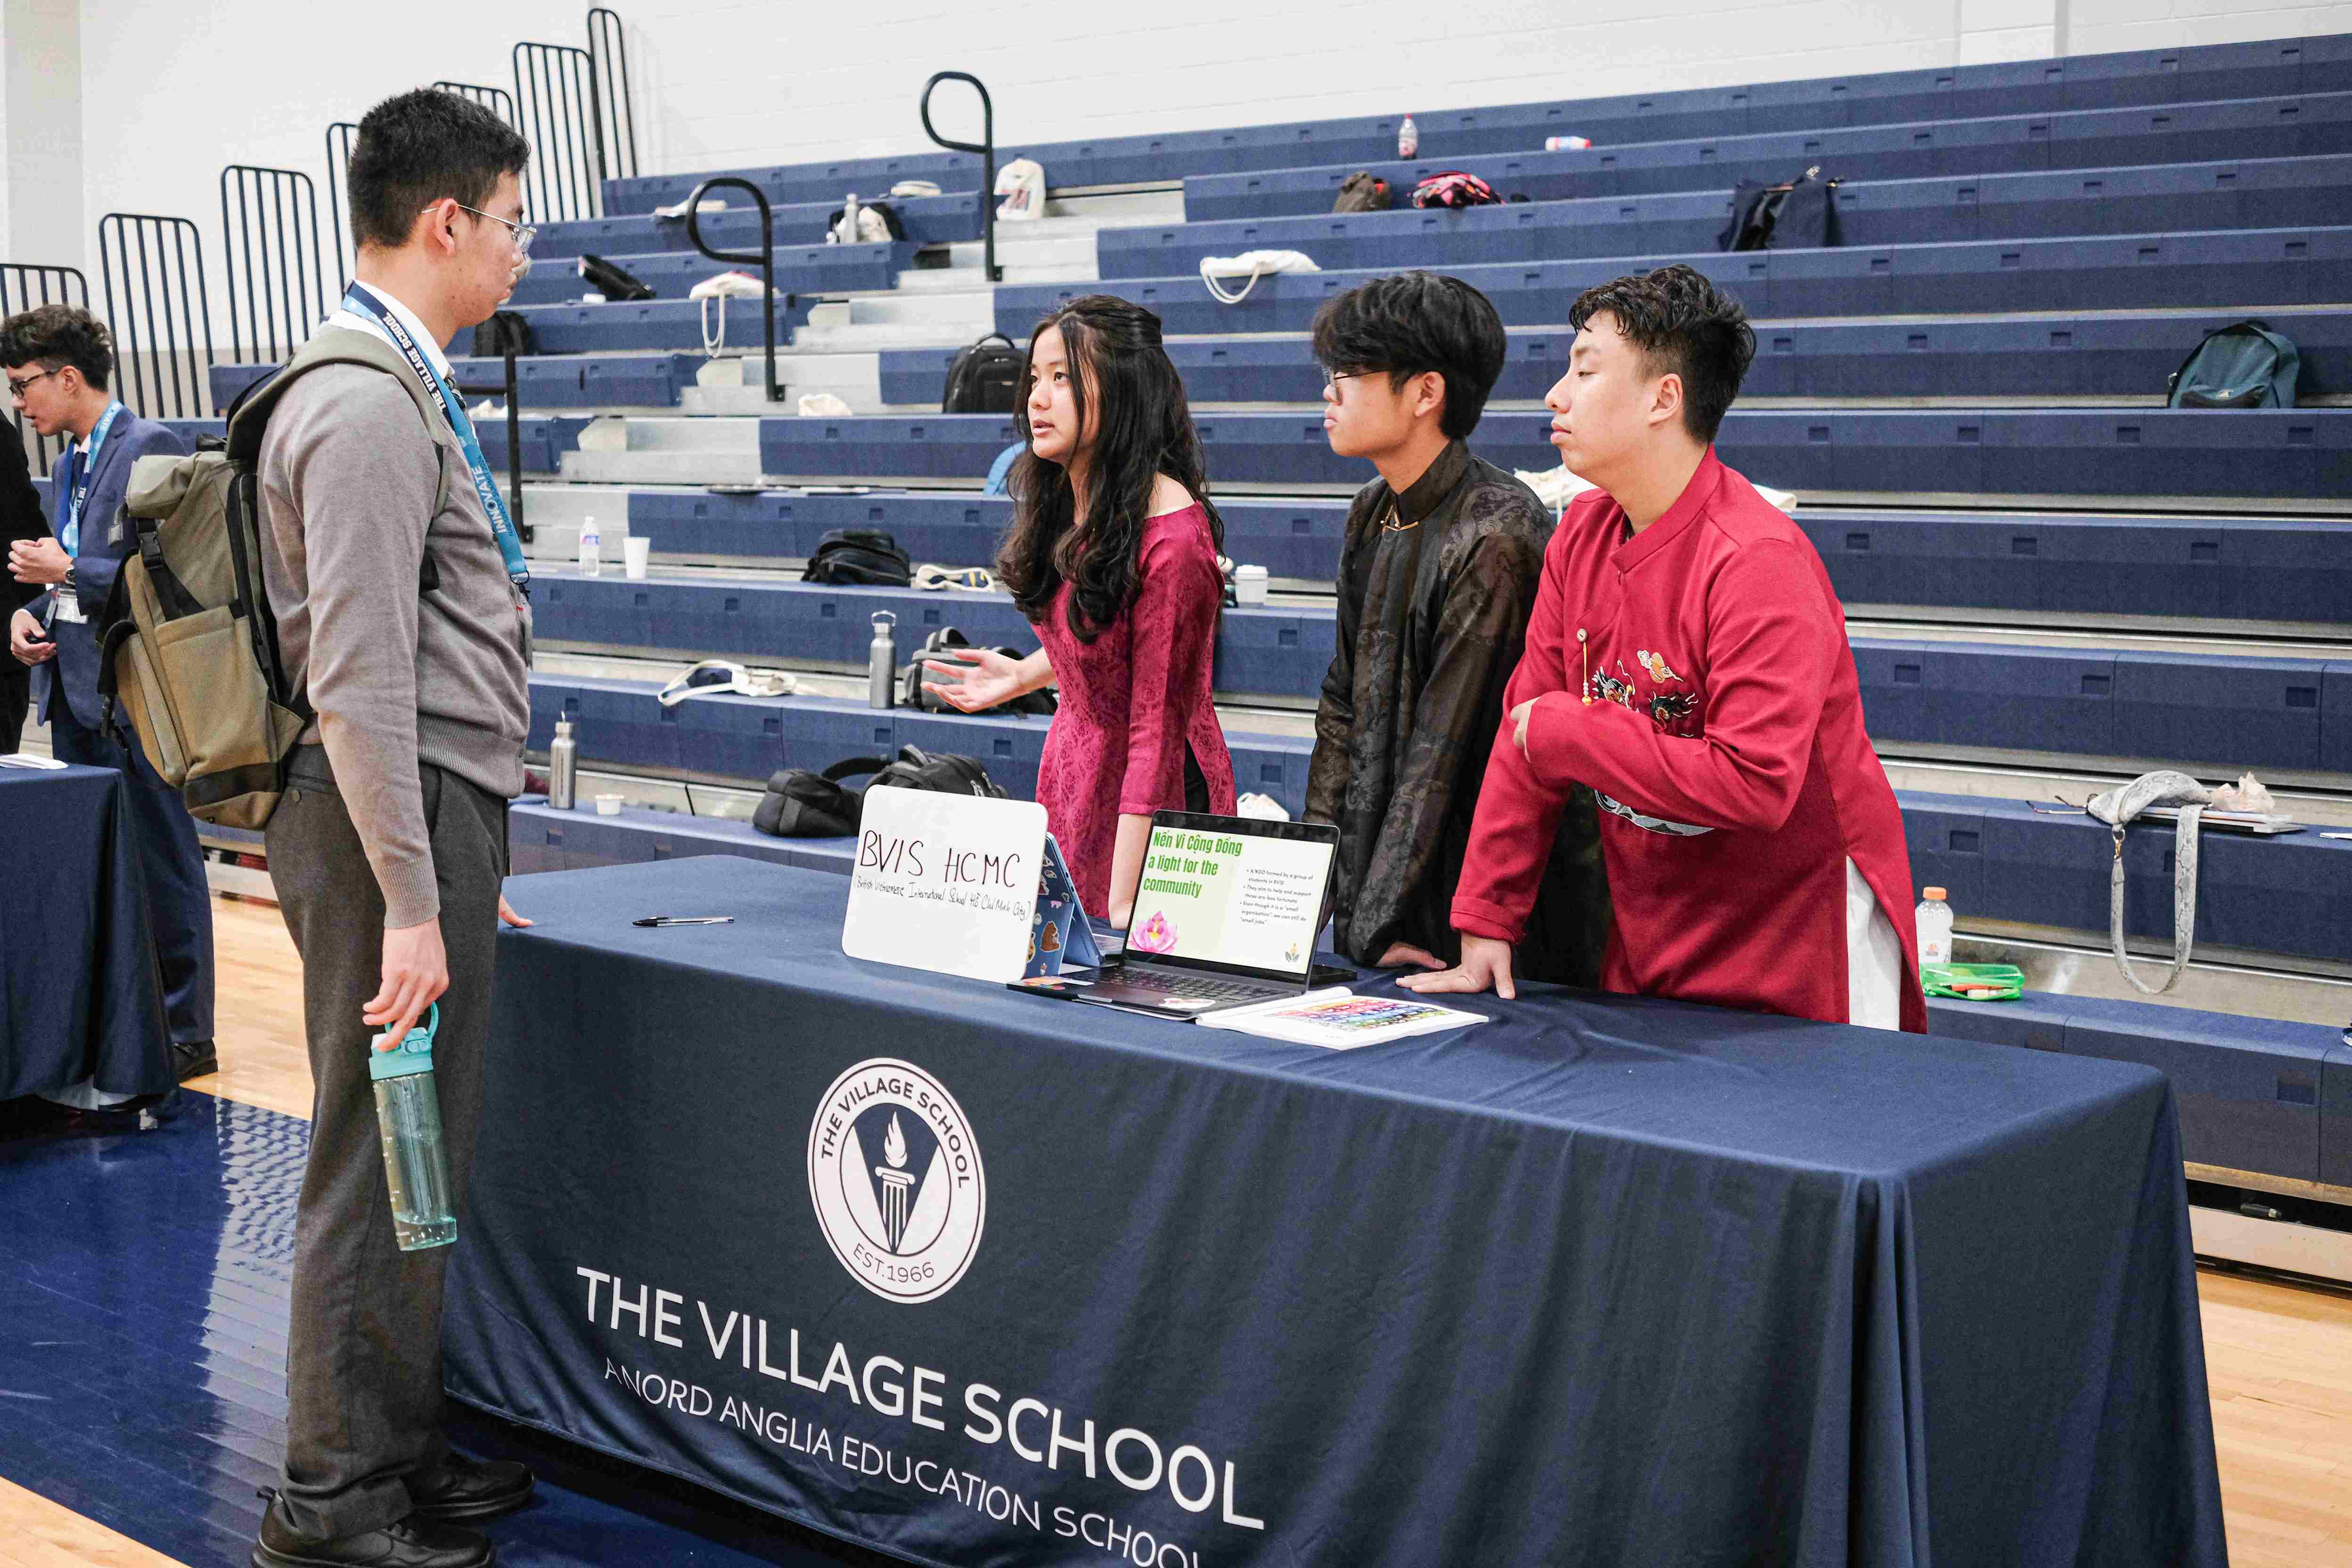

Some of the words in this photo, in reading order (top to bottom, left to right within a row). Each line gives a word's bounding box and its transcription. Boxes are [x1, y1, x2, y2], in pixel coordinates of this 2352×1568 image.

[382, 312, 413, 349] SCHOOL
[407, 347, 436, 392] VILLAGE
[431, 390, 447, 410] THE
[471, 465, 506, 533] INNOVATE
[860, 830, 923, 876] BVIS
[944, 848, 1020, 888] HCMC
[1148, 856, 1155, 868] a
[1157, 855, 1181, 871] light
[1183, 858, 1199, 873] for
[1200, 859, 1218, 875] the
[1176, 833, 1186, 849] Vì
[1187, 834, 1214, 853] Cộng
[1215, 837, 1243, 857] Đồng
[1143, 878, 1202, 898] community
[821, 1113, 843, 1160] THE
[838, 1078, 914, 1112] VILLAGE
[916, 1092, 970, 1189] SCHOOL
[577, 1266, 683, 1348] THE
[697, 1301, 945, 1431] VILLAGE
[964, 1383, 1264, 1530] SCHOOL
[604, 1357, 623, 1385] A
[621, 1364, 712, 1417] NORD
[719, 1396, 833, 1462] ANGLIA
[842, 1436, 1040, 1531] EDUCATION
